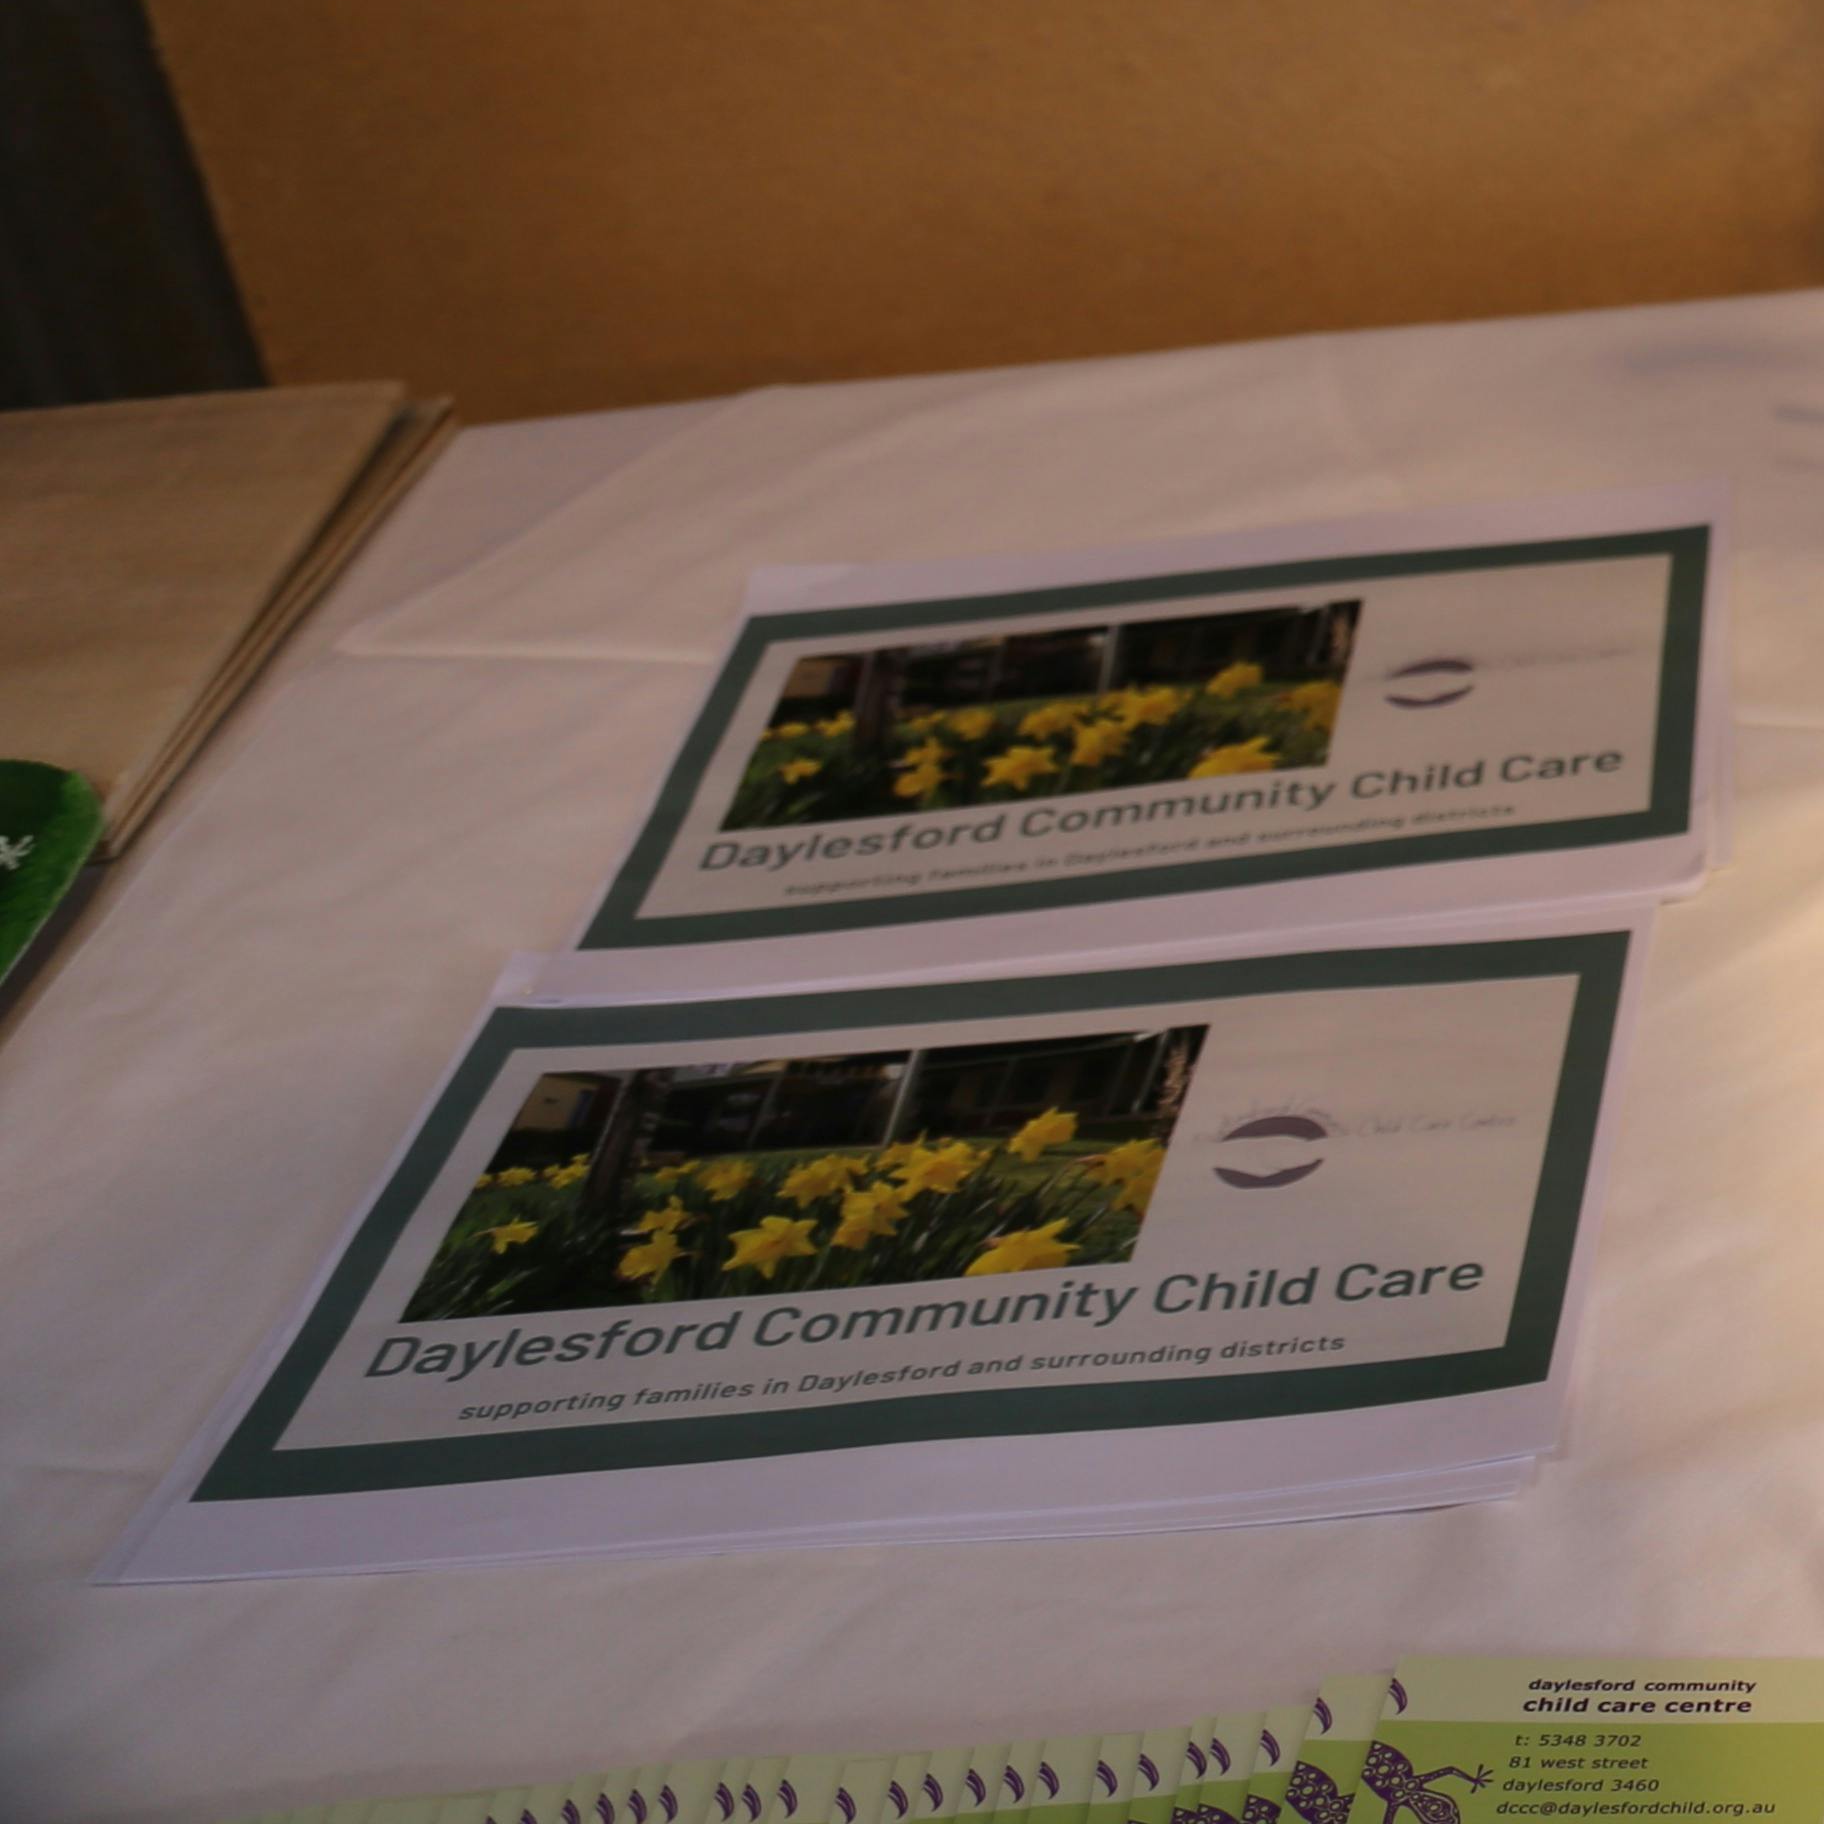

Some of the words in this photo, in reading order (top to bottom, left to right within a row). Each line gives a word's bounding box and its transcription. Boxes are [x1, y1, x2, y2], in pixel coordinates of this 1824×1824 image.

[699, 815, 1006, 871] Daylesford
[1019, 780, 1338, 838] Community
[1350, 761, 1487, 800] Child
[1500, 749, 1624, 783] Care
[364, 1310, 742, 1382] Daylesford
[754, 1280, 1139, 1348] Community
[1153, 1268, 1320, 1314] Child
[1335, 1262, 1485, 1302] Care
[458, 1390, 626, 1422] supporting
[632, 1377, 755, 1408] families
[762, 1378, 790, 1396] in
[798, 1360, 962, 1395] Daylesford
[967, 1352, 1022, 1376] and
[1030, 1342, 1212, 1371] surrounding
[1220, 1334, 1346, 1360] districts
[1528, 1679, 1636, 1693] daylesford
[1644, 1679, 1757, 1694] community
[1523, 1697, 1590, 1713] child
[1597, 1699, 1656, 1713] care
[1665, 1698, 1753, 1713] centre
[1514, 1734, 1530, 1747] t:
[1538, 1734, 1587, 1747] 5348
[1594, 1734, 1642, 1747] 3702
[1508, 1756, 1531, 1769] 81
[1541, 1757, 1585, 1769] west
[1591, 1757, 1649, 1769] street
[1502, 1778, 1604, 1794] daylesford
[1611, 1779, 1660, 1792] 3460
[1496, 1801, 1776, 1817] dccc@daylesfordchild.org.au
